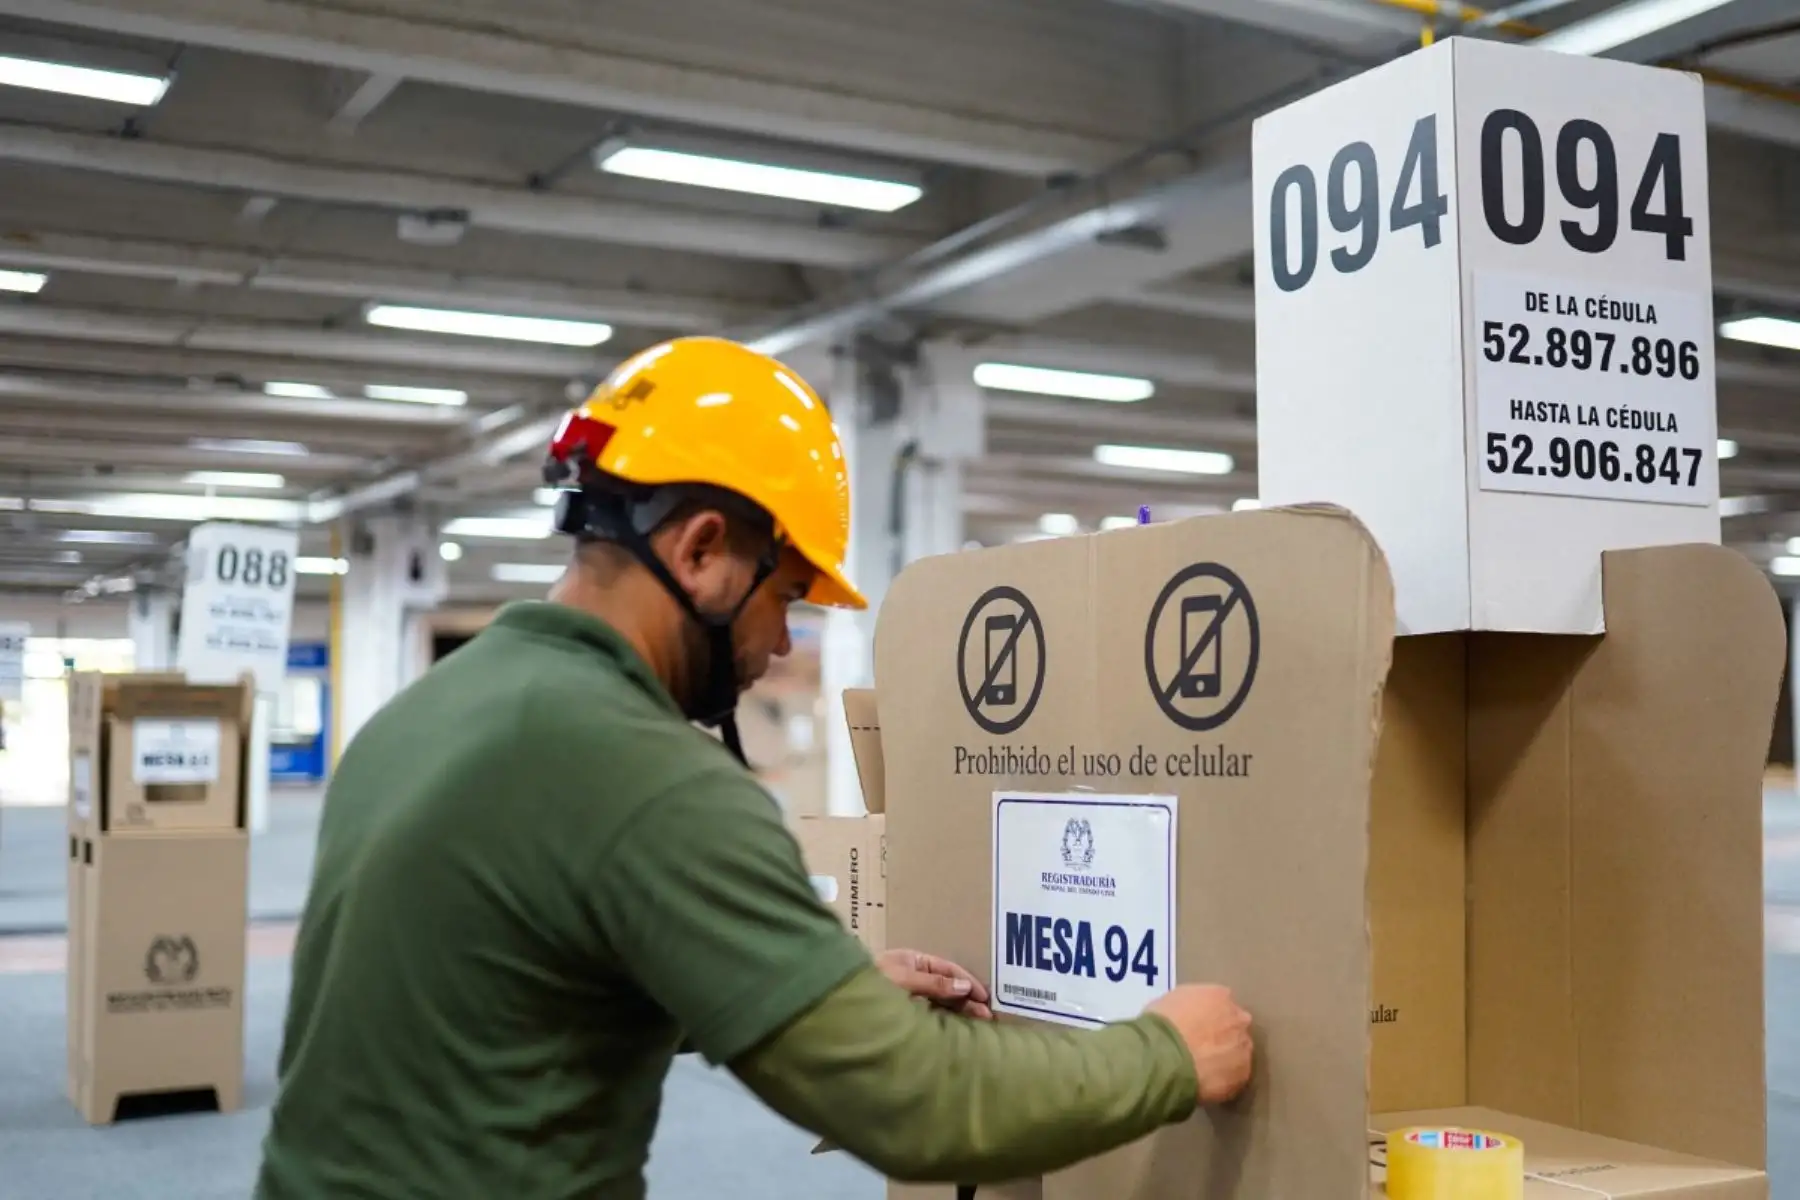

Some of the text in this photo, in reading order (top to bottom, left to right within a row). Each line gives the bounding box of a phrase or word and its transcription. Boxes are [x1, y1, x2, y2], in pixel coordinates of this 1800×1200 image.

[1270, 113, 1448, 292] 094
[1480, 108, 1694, 262] 094
[1525, 291, 1657, 324] DE LA CÉDULA
[1483, 320, 1699, 380] 52.897.896
[1510, 399, 1678, 433] HASTA LA CÉDULA
[1487, 432, 1702, 487] 52.906.847
[218, 543, 288, 591] 088
[954, 744, 1253, 778] Prohibido el uso de celular
[850, 847, 859, 929] PRIMERO
[1041, 872, 1116, 888] REGISTRADURÍA
[1005, 912, 1158, 986] MESA 94
